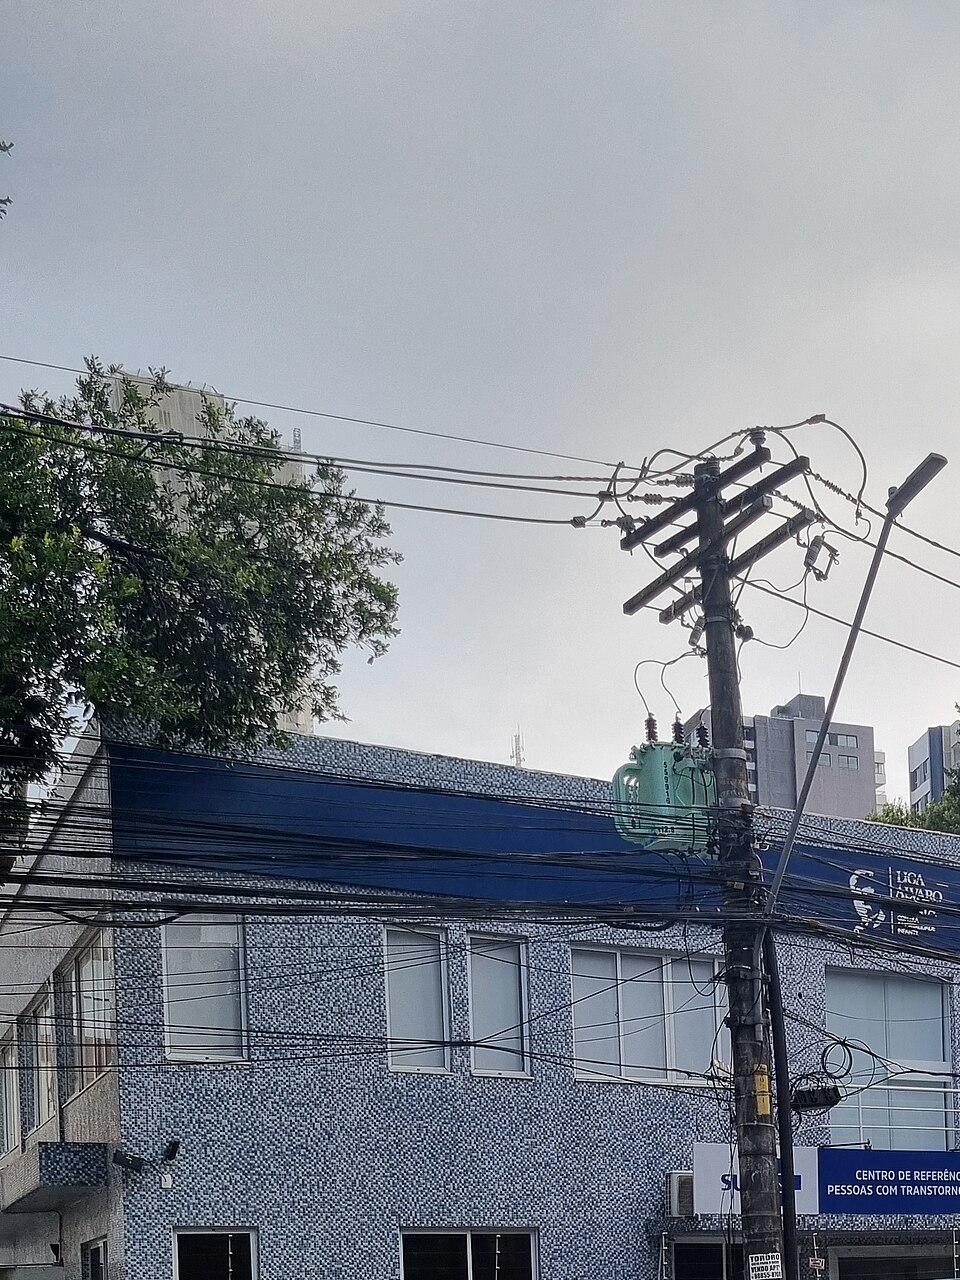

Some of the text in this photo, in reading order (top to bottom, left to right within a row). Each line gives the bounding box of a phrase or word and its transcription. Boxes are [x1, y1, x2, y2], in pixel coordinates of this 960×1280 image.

[855, 1170, 895, 1181] CENTRO
[898, 1170, 911, 1181] DE
[827, 1185, 873, 1196] PESSOAS
[876, 1185, 898, 1196] COM
